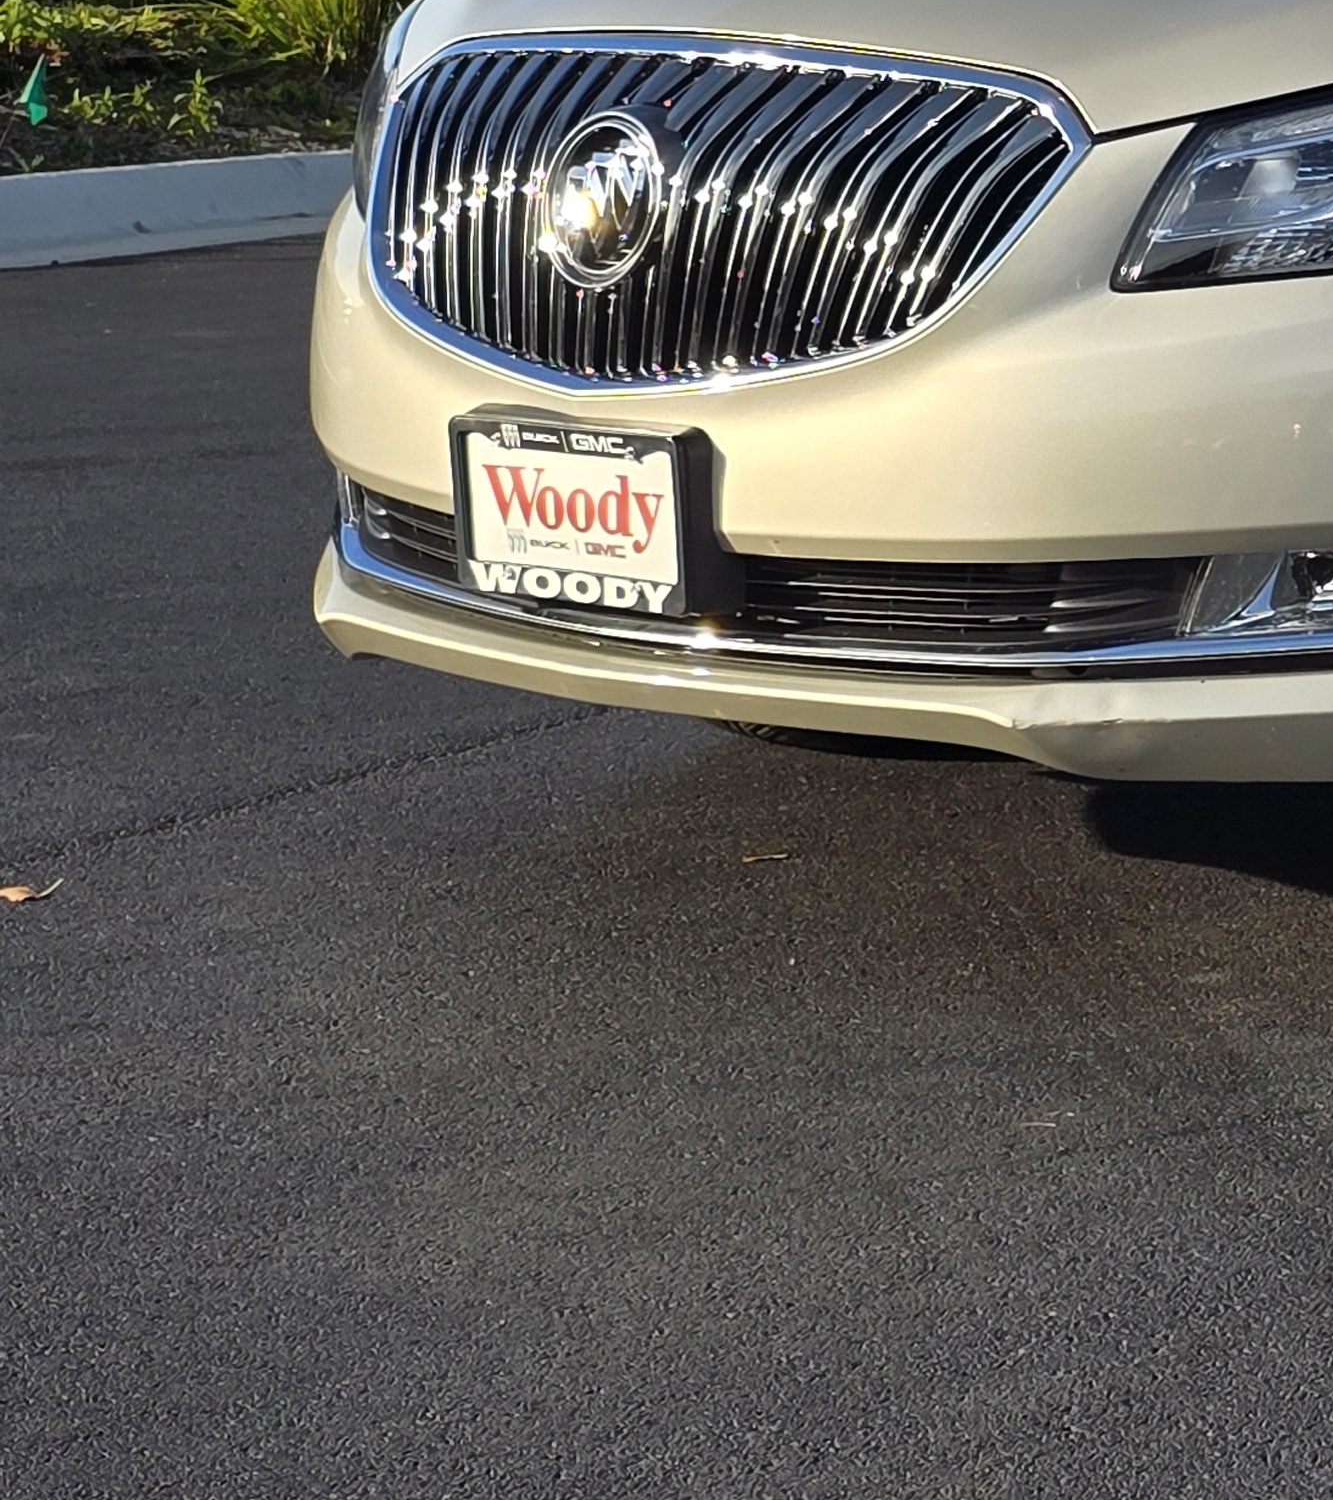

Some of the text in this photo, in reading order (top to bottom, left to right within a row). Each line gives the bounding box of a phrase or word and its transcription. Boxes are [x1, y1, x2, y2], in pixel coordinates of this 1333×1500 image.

[522, 432, 625, 453] BUICK GMC
[482, 464, 665, 553] Woody
[468, 560, 673, 613] WOODY
